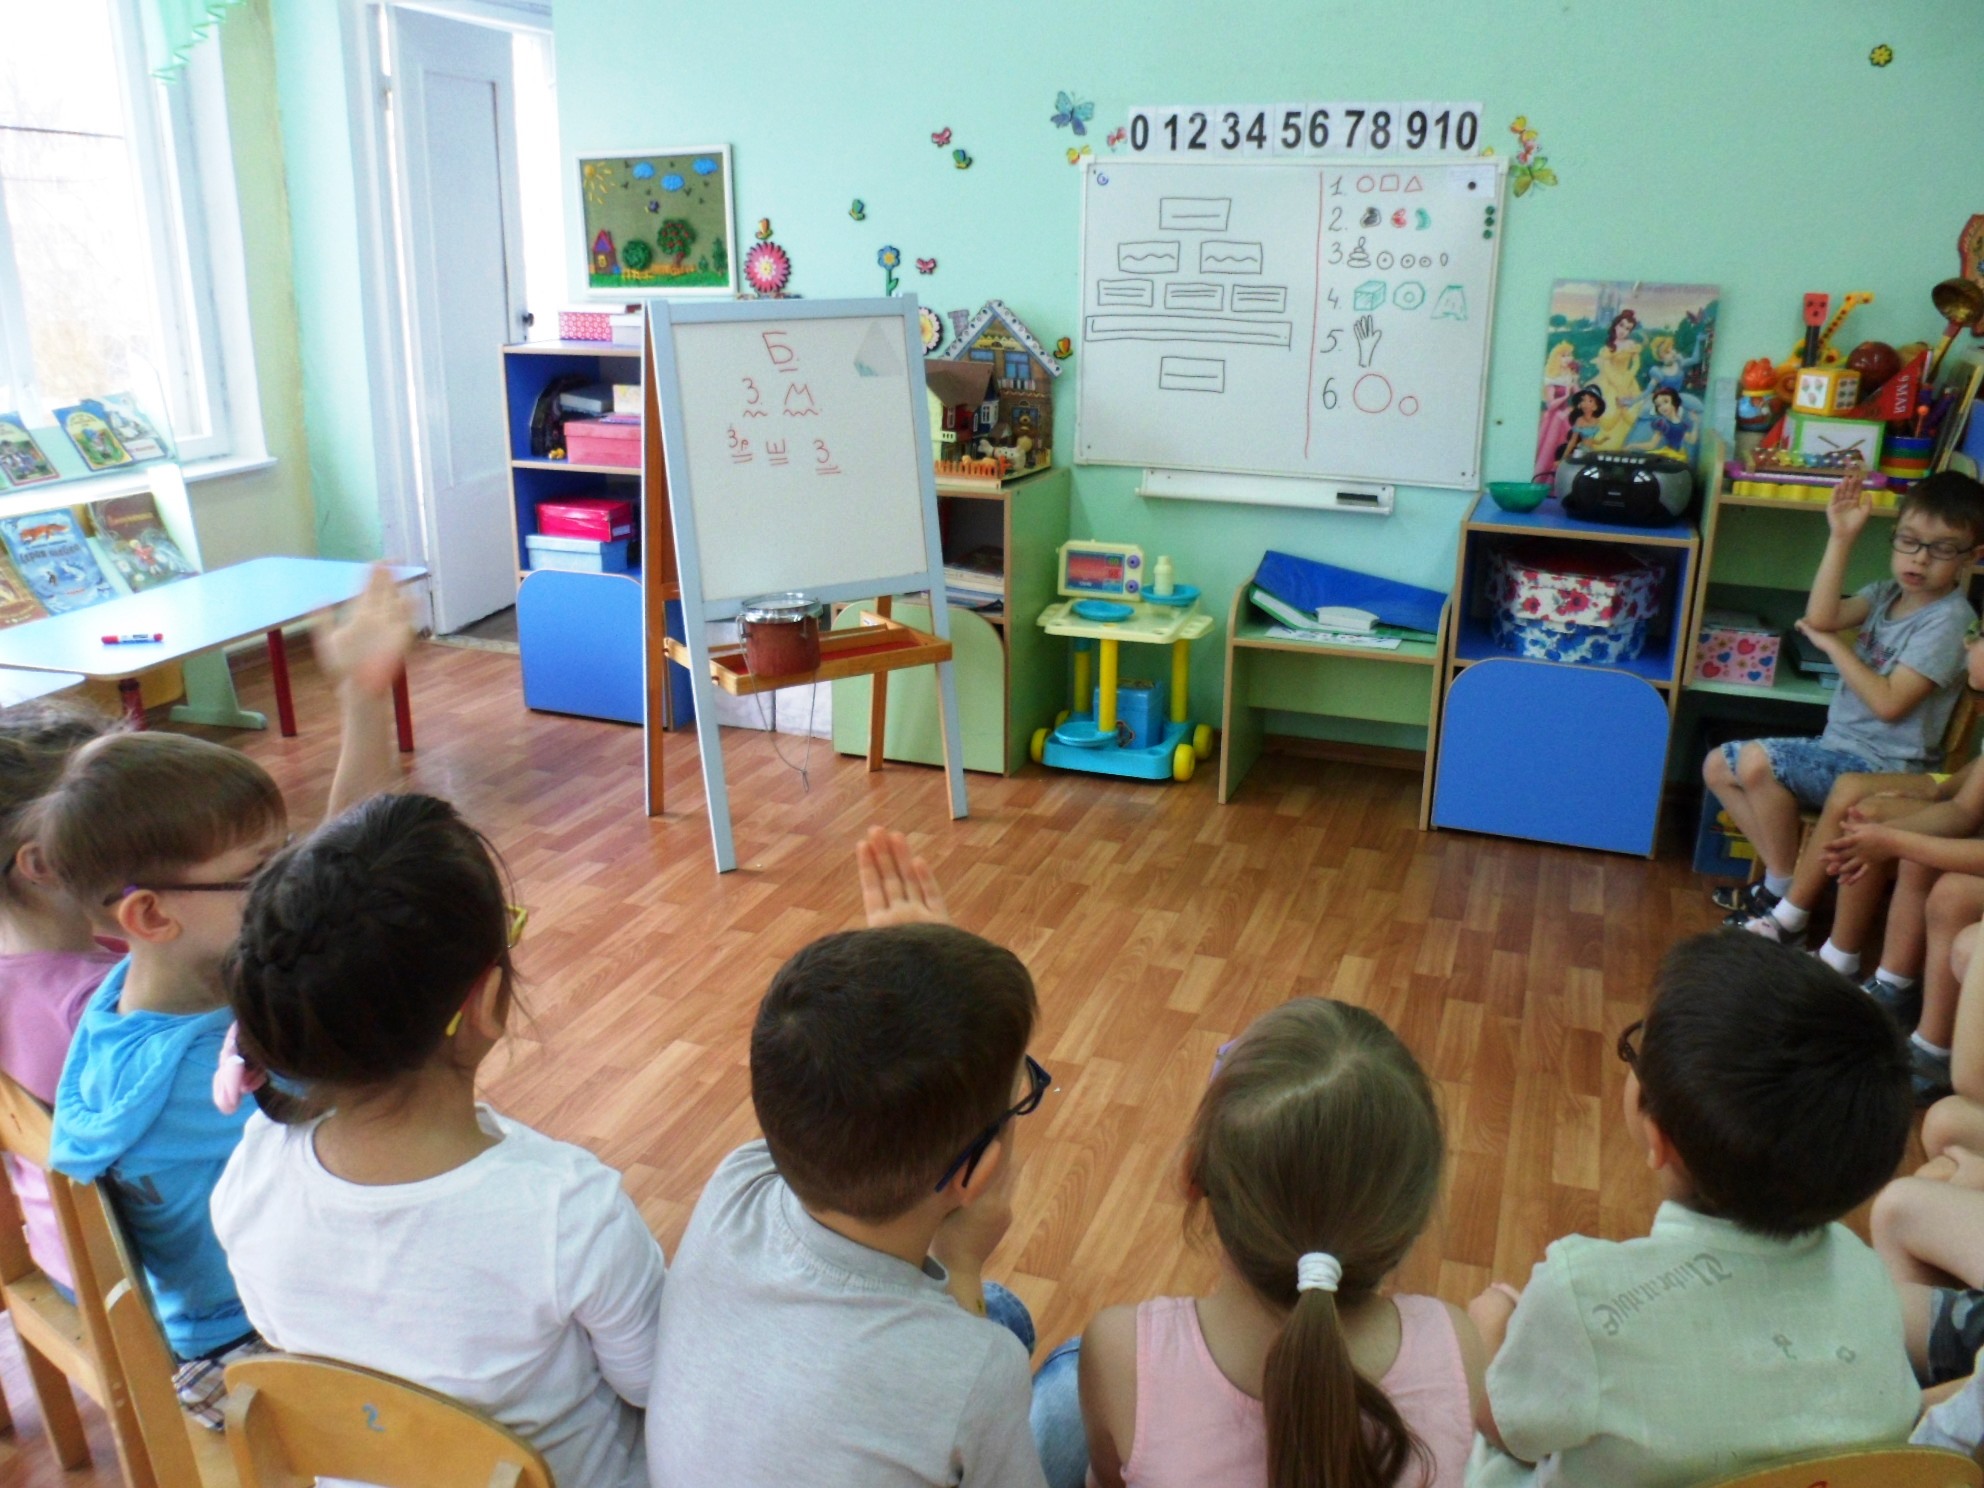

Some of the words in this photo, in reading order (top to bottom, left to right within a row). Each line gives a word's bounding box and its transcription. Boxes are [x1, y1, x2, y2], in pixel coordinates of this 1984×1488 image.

[1131, 114, 1150, 151] 0
[1164, 114, 1178, 151] 1
[1188, 112, 1208, 150] 2
[1221, 111, 1241, 150] 3
[1245, 112, 1267, 150] 4
[1281, 111, 1302, 149] 5
[1309, 110, 1330, 148] 6
[1345, 110, 1366, 148] 7
[1371, 110, 1391, 150] 8
[1406, 110, 1428, 150] 9
[1435, 110, 1478, 151] 10
